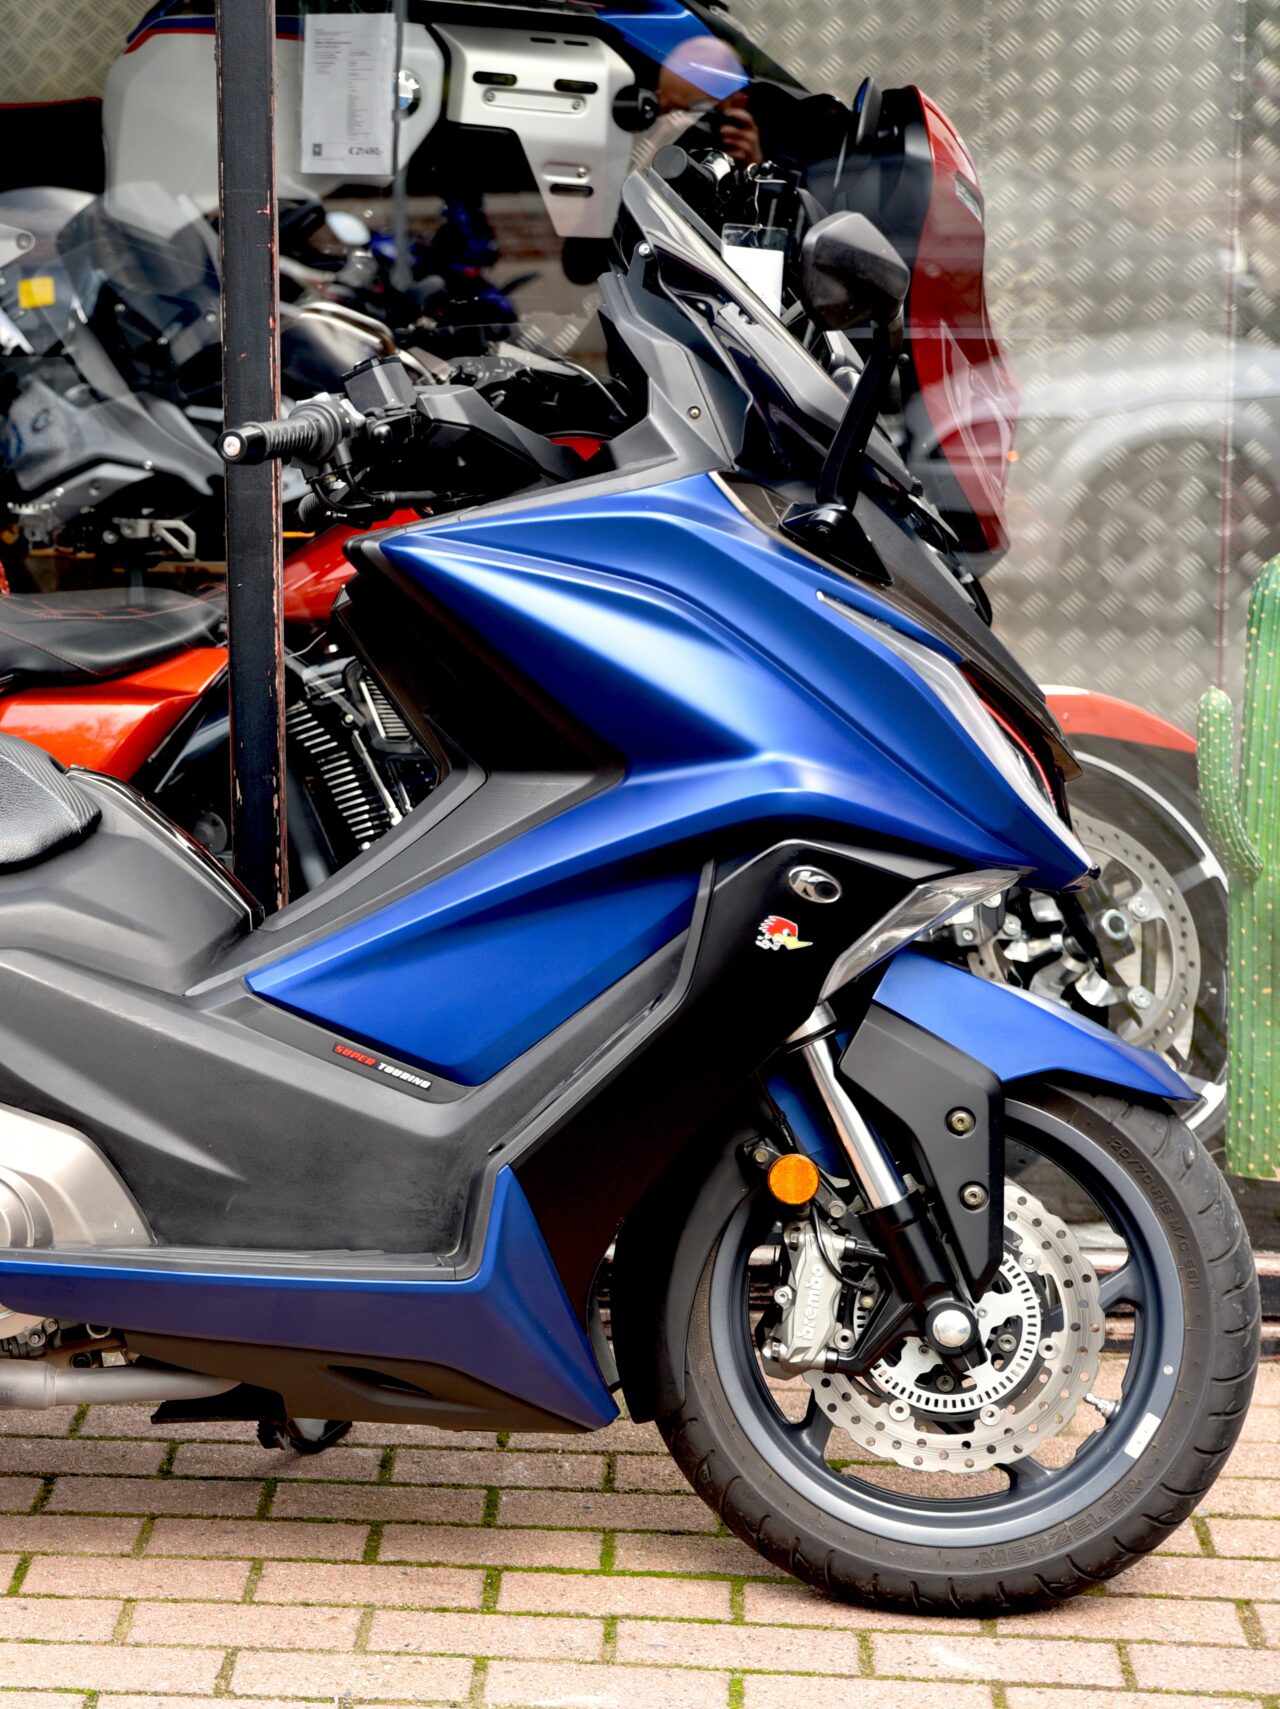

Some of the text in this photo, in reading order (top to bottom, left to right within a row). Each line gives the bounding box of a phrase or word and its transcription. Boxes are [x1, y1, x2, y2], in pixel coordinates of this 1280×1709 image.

[334, 1044, 432, 1089] SUPER TOURING
[796, 1263, 825, 1341] brembo
[977, 1478, 1144, 1569] METZELER
